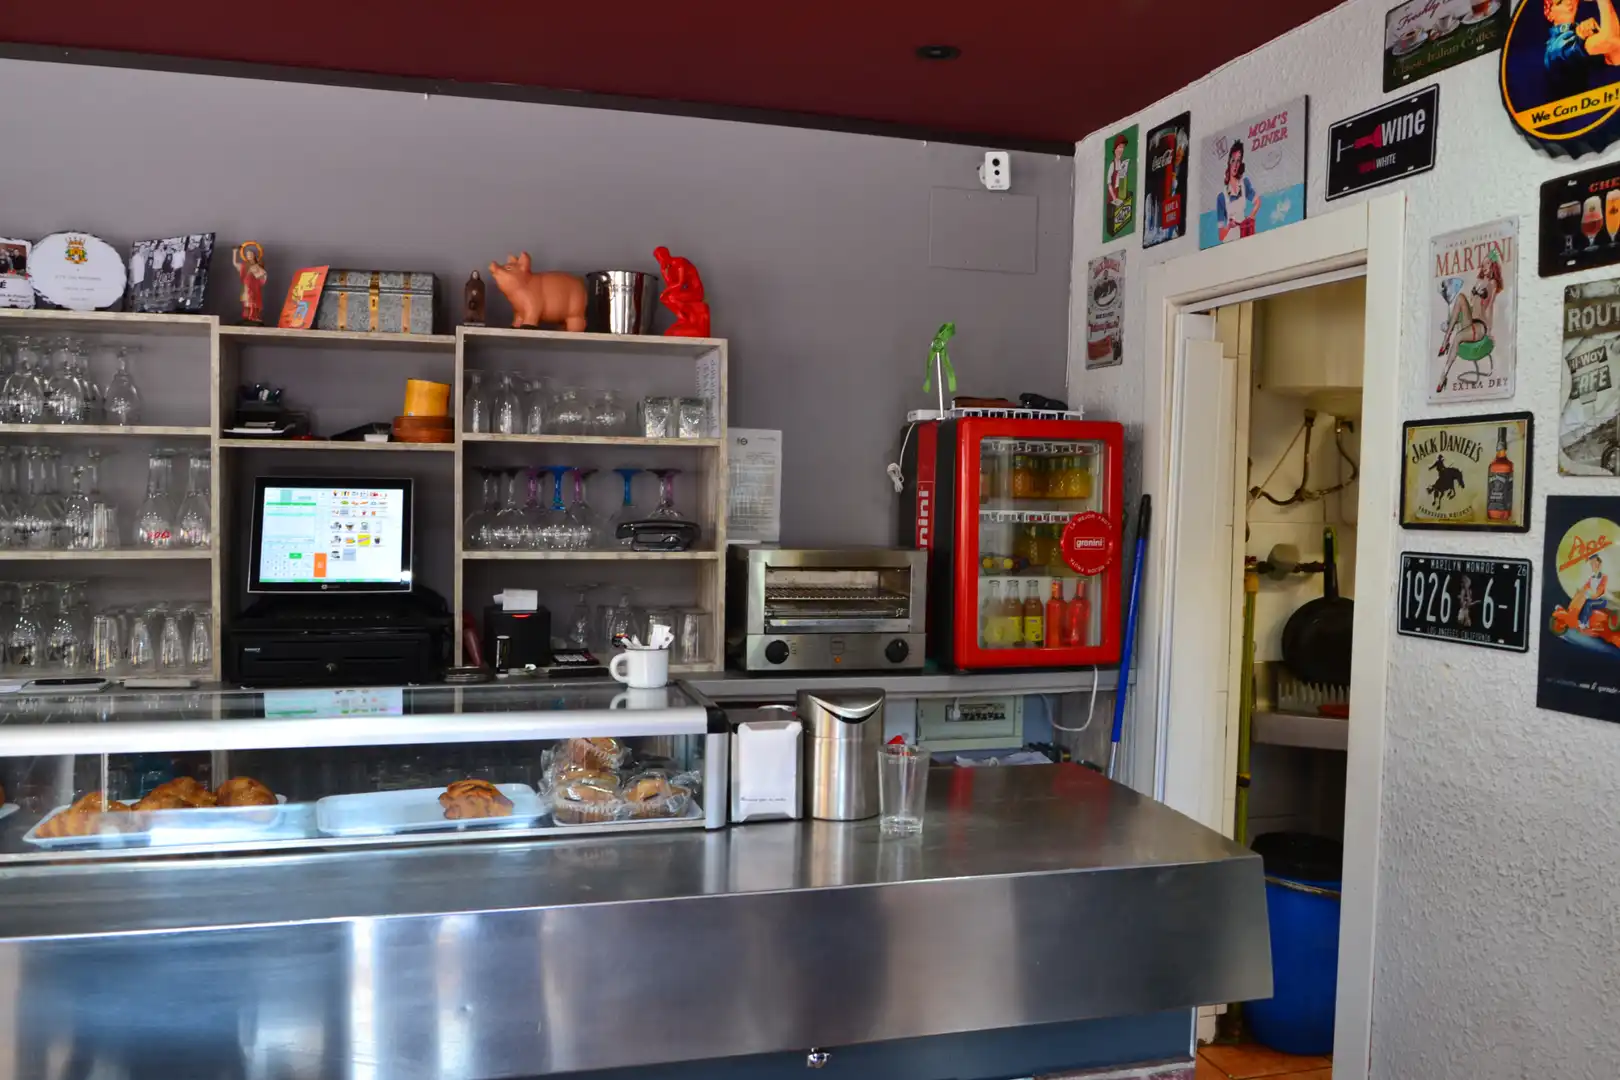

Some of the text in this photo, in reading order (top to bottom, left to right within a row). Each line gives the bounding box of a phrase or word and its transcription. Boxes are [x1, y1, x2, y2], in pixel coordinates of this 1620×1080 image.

[1532, 88, 1620, 124] We Can Do It!
[1248, 111, 1288, 139] MOM'S
[1251, 127, 1288, 151] DINER
[1376, 153, 1397, 169] WHITE
[1434, 236, 1512, 278] MARTINI
[1567, 302, 1620, 332] ROUT
[1453, 377, 1508, 391] EXTRA DRY
[1572, 367, 1609, 397] CAFE
[1412, 430, 1483, 464] JACK DANIEL'S
[918, 490, 929, 552] nini
[1076, 537, 1103, 548] granini
[1430, 559, 1495, 574] MARILYN MONROE
[1517, 565, 1527, 576] 26
[1405, 570, 1520, 633] 1926 6-1
